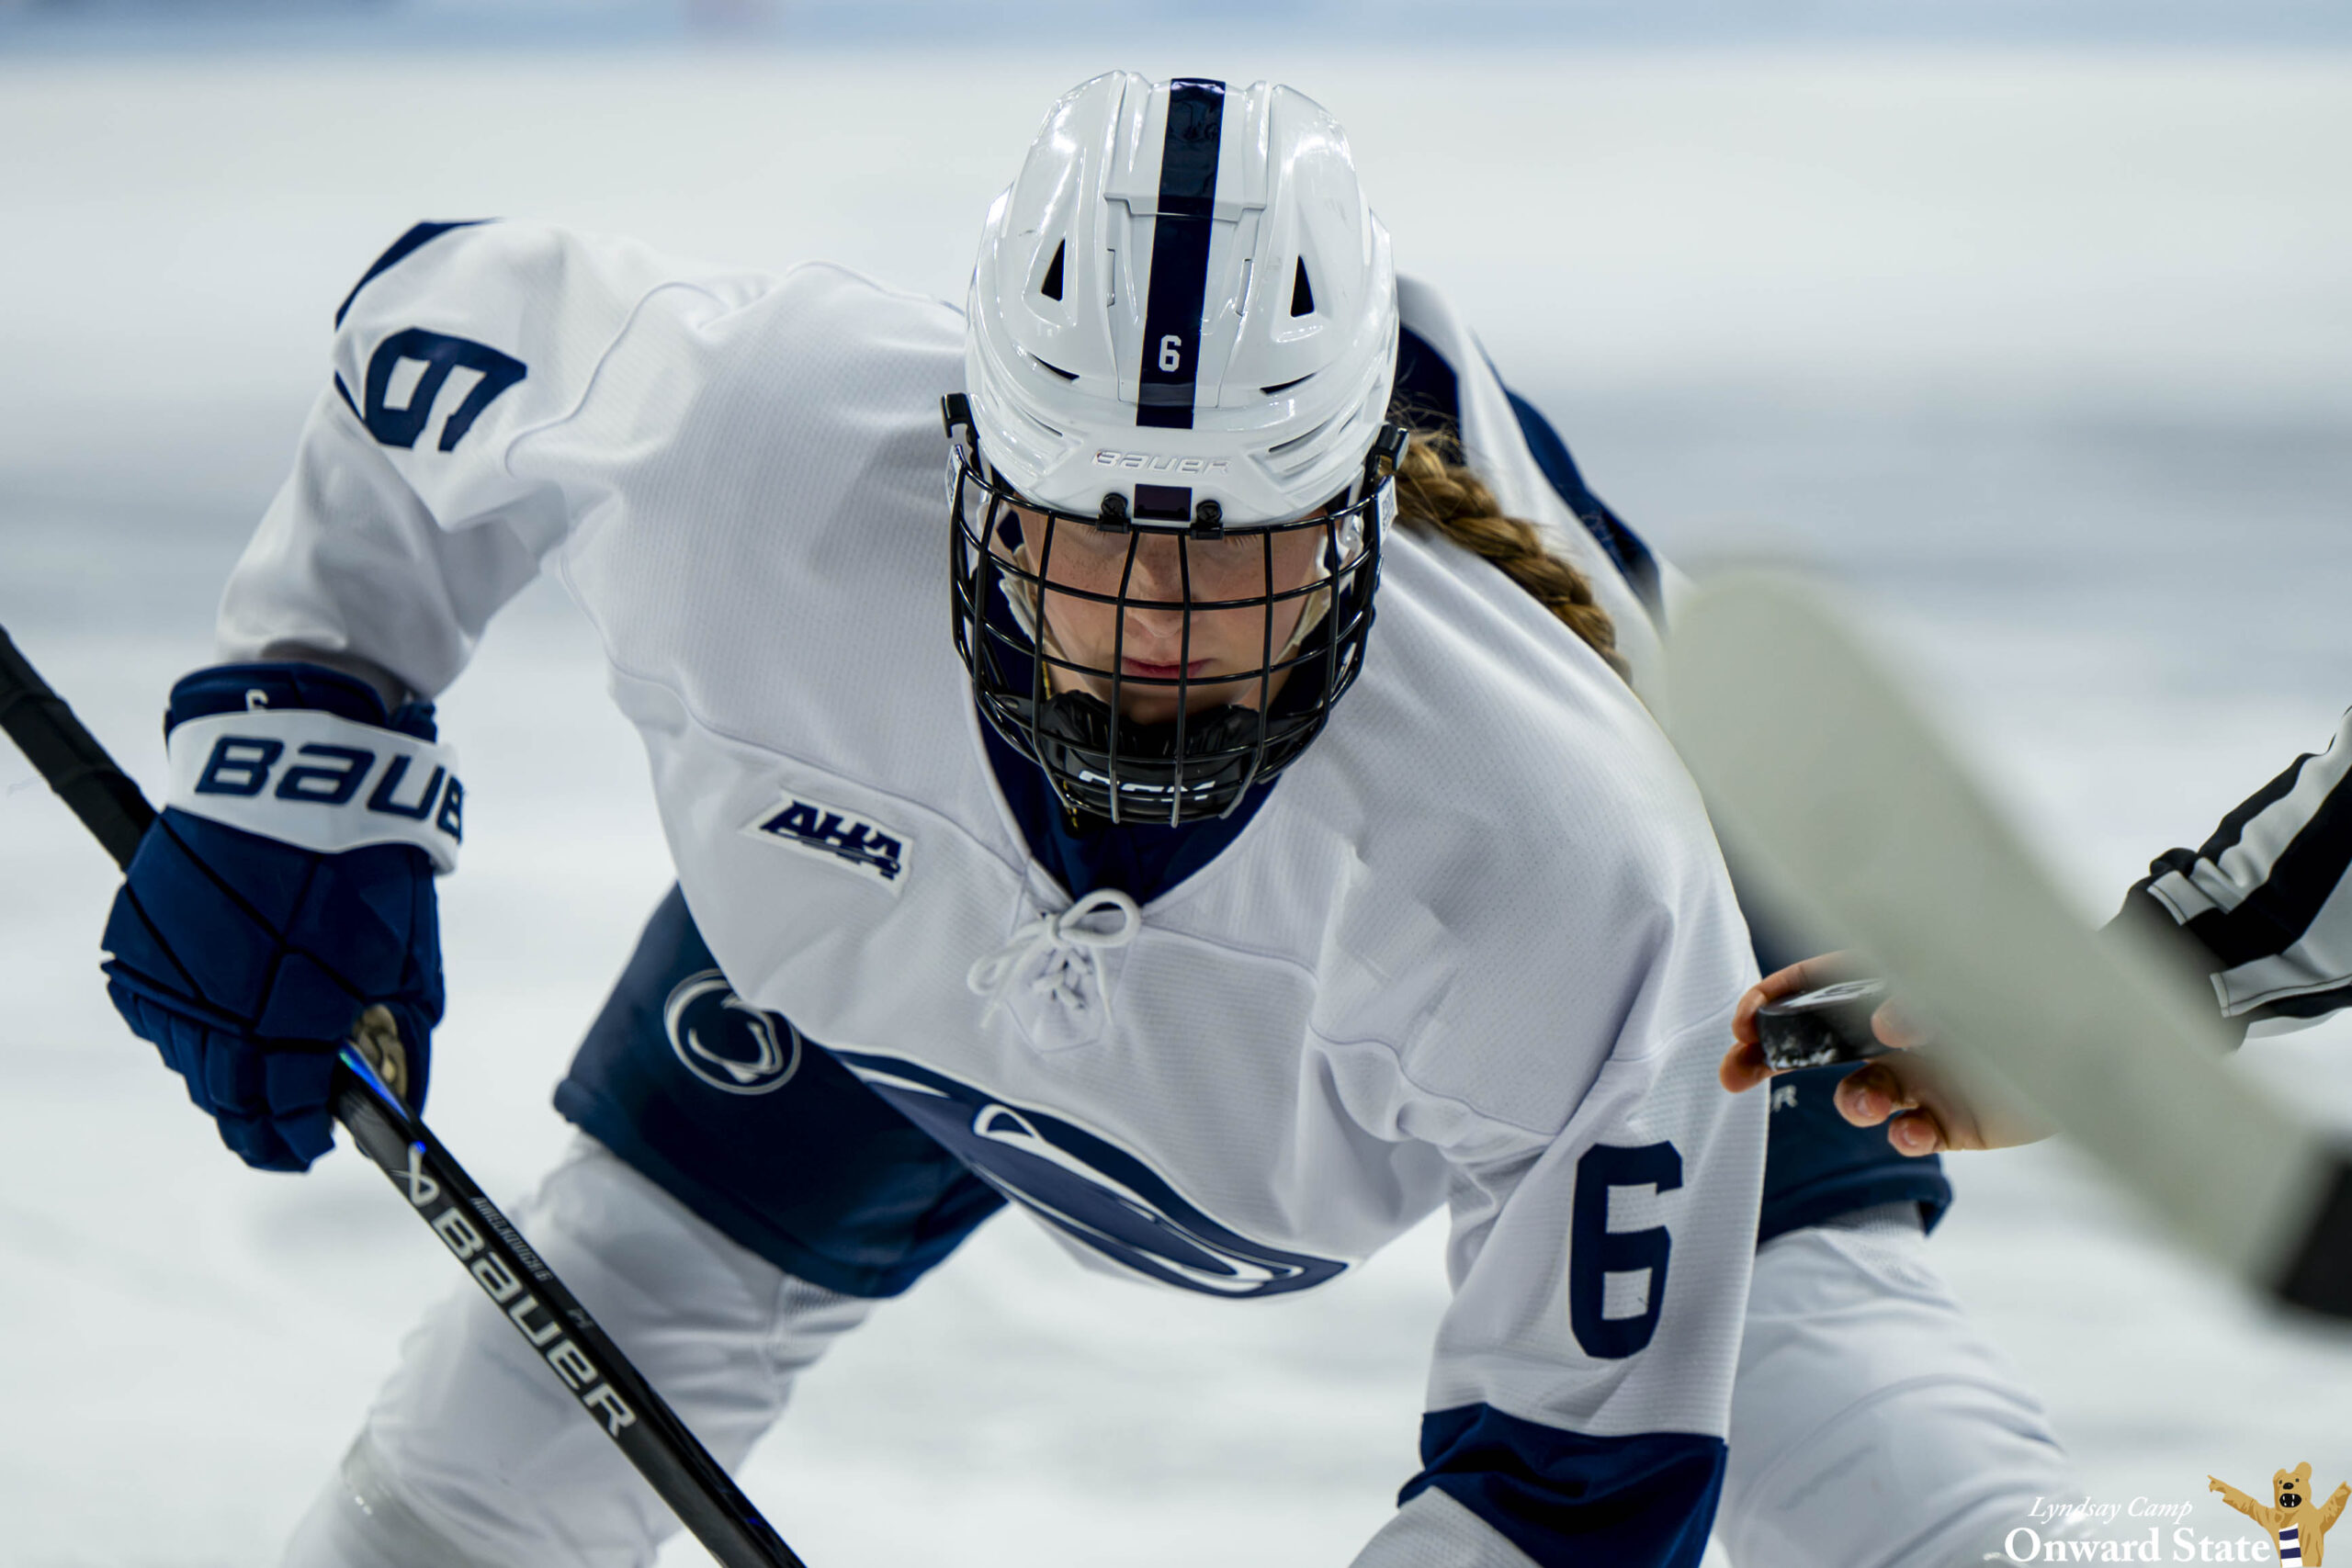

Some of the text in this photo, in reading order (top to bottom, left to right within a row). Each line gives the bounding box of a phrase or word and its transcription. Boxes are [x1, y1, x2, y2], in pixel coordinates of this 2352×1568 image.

[1159, 334, 1182, 372] 6
[759, 798, 901, 865] AHA
[1569, 1140, 1683, 1360] 6
